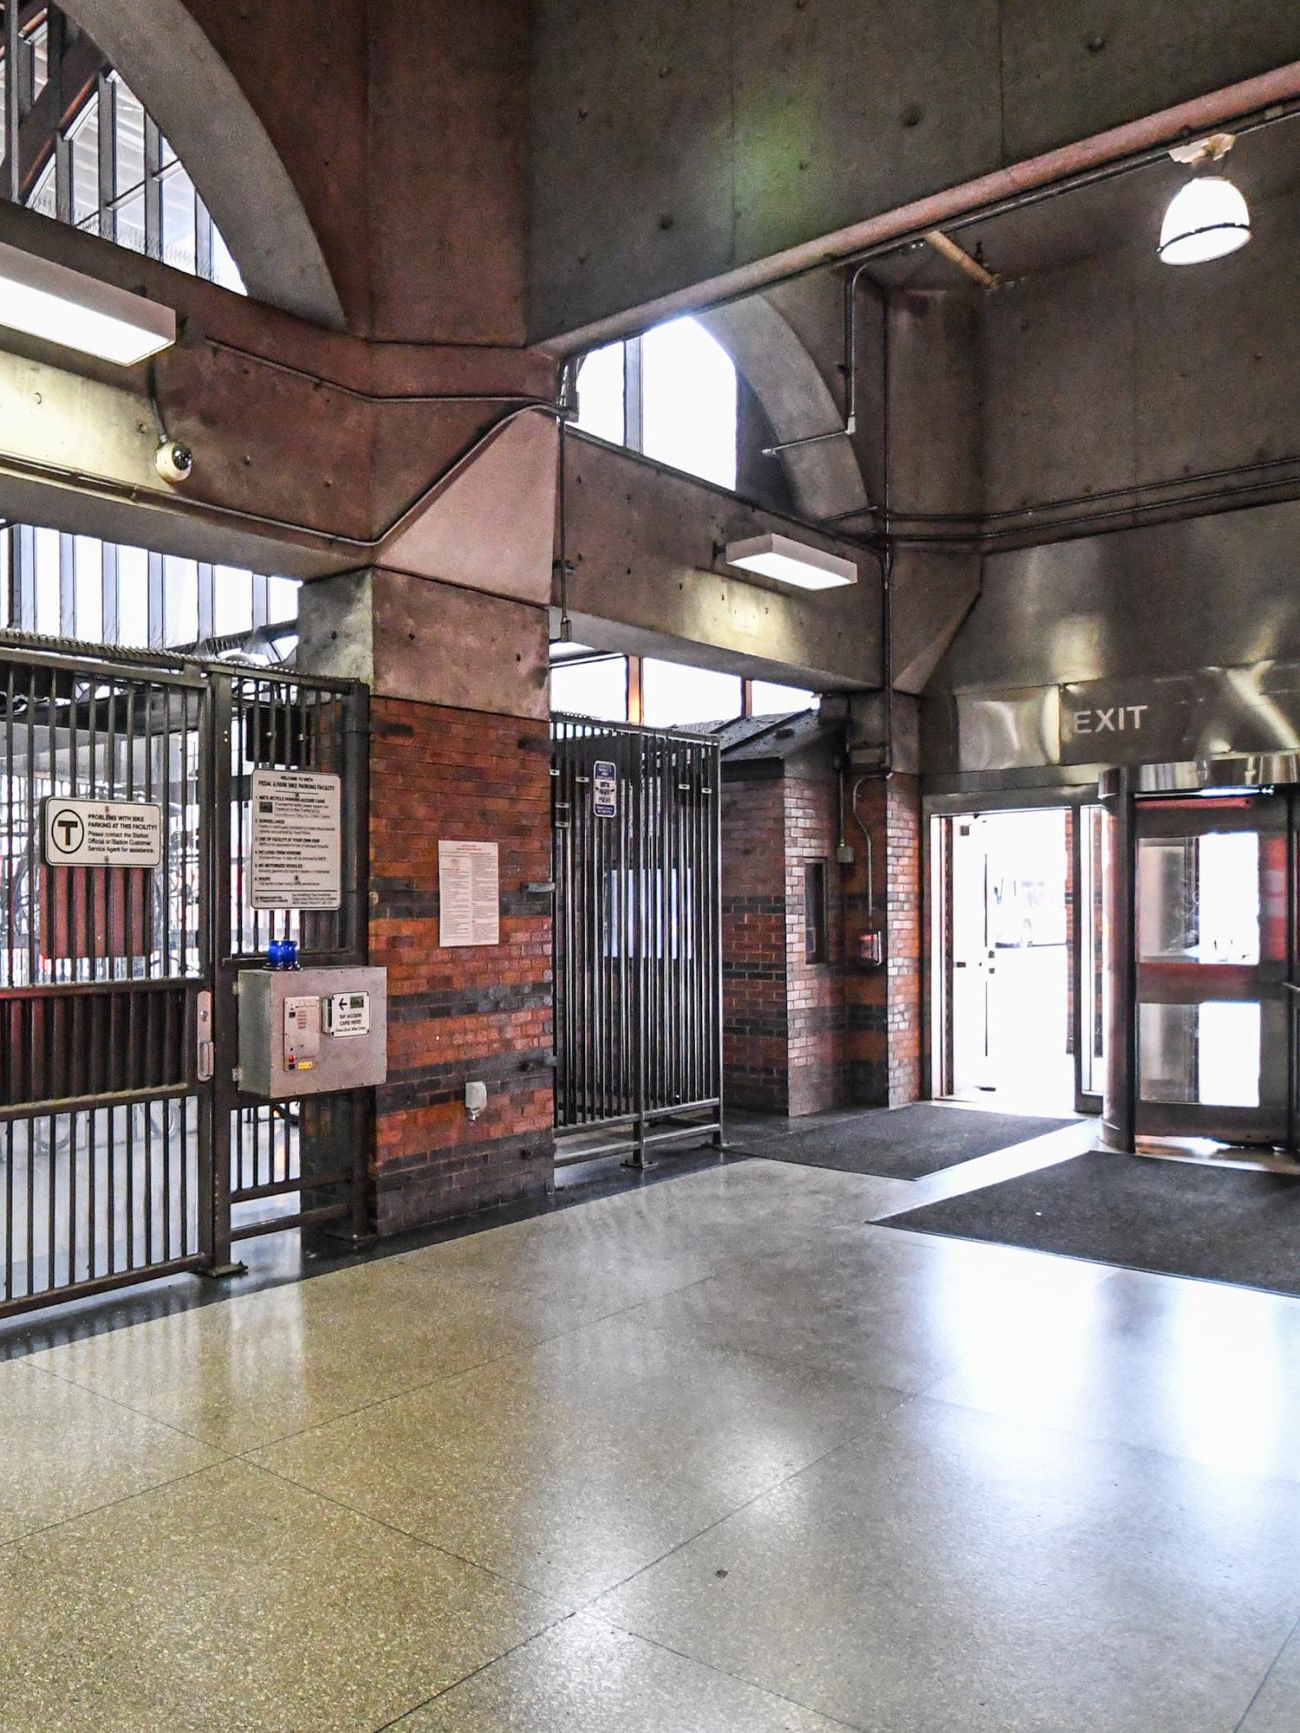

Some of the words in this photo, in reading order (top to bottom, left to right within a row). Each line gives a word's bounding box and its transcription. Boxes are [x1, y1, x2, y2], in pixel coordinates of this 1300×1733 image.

[1072, 704, 1149, 735] EXIT
[87, 813, 117, 822] PROBLEMS
[87, 821, 112, 829] PARKING
[57, 820, 78, 847] T
[132, 831, 149, 839] Station
[106, 846, 121, 854] Agent
